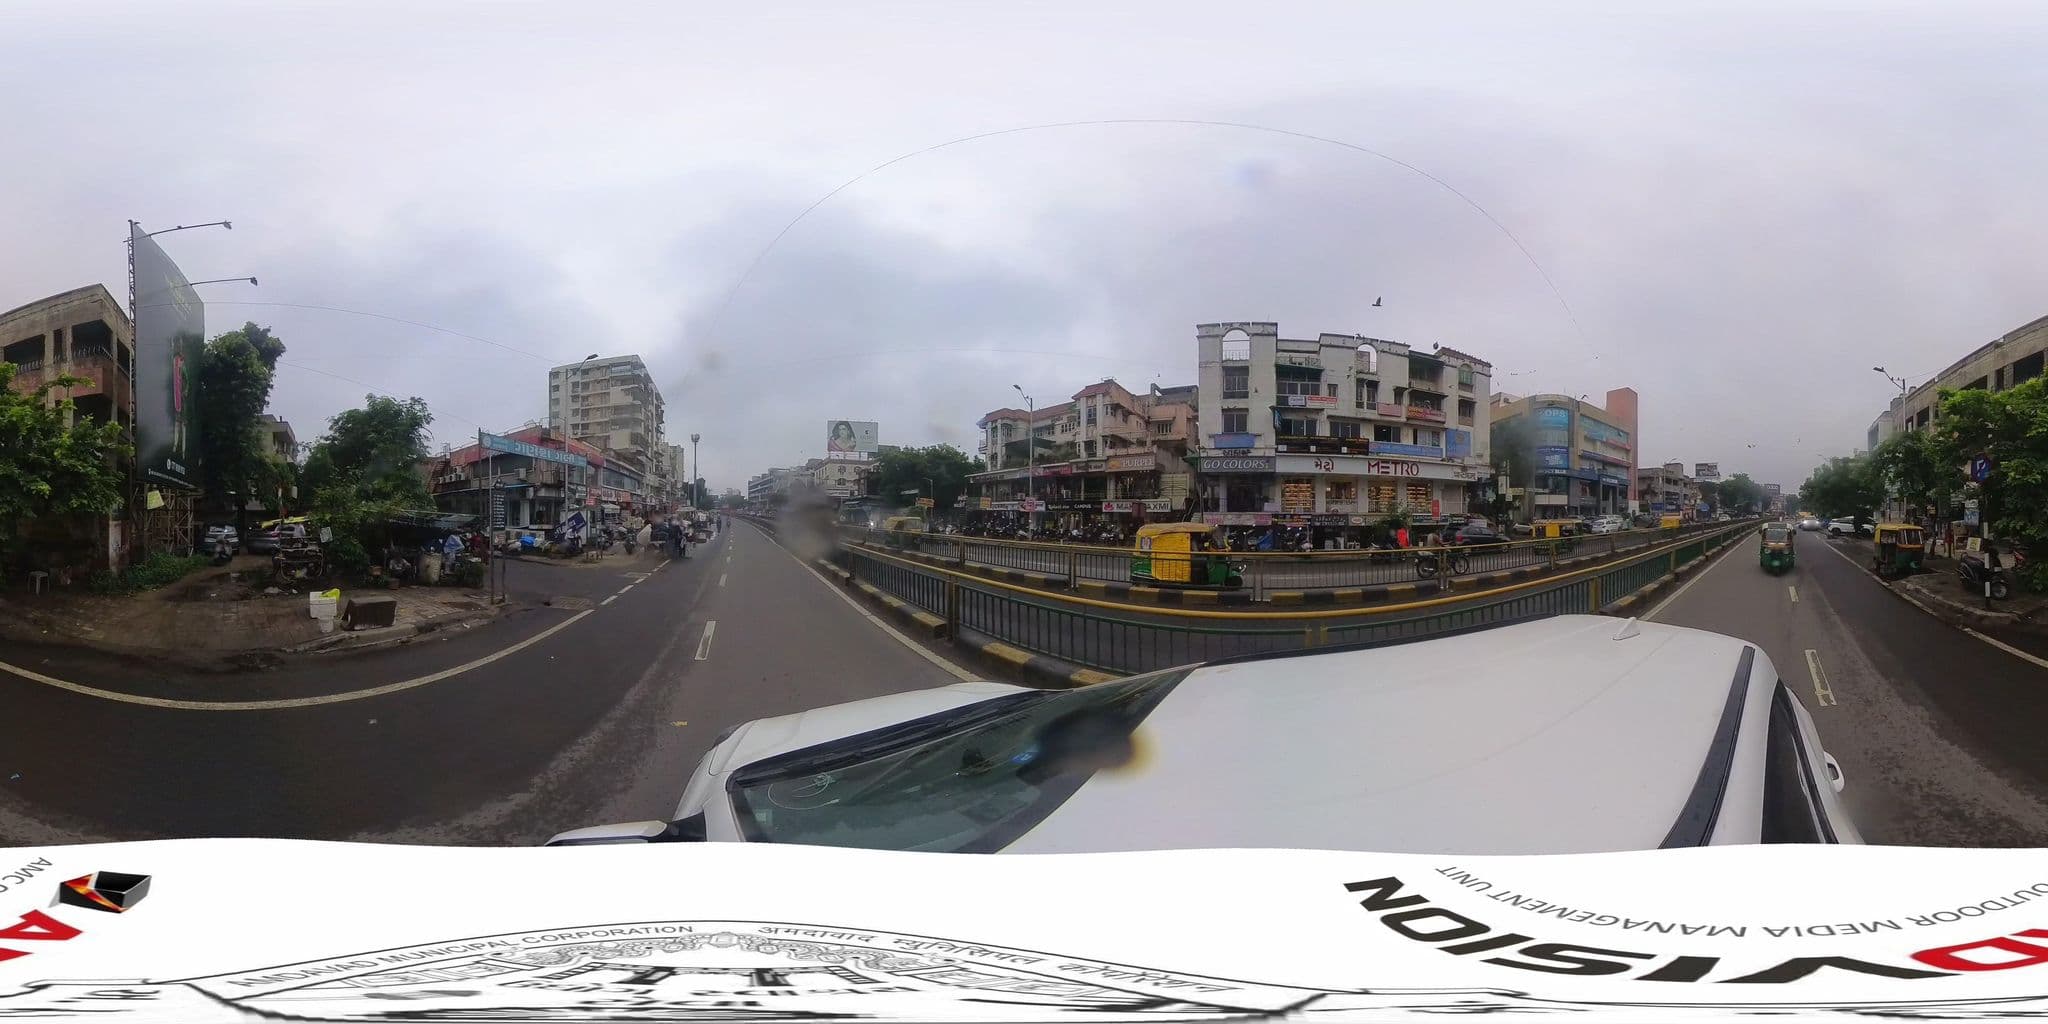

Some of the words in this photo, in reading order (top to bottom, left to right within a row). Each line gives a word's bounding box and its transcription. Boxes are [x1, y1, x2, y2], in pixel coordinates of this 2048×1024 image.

[1203, 459, 1220, 469] GO
[1314, 457, 1334, 472] મેટ્રો
[1367, 459, 1420, 476] METRO
